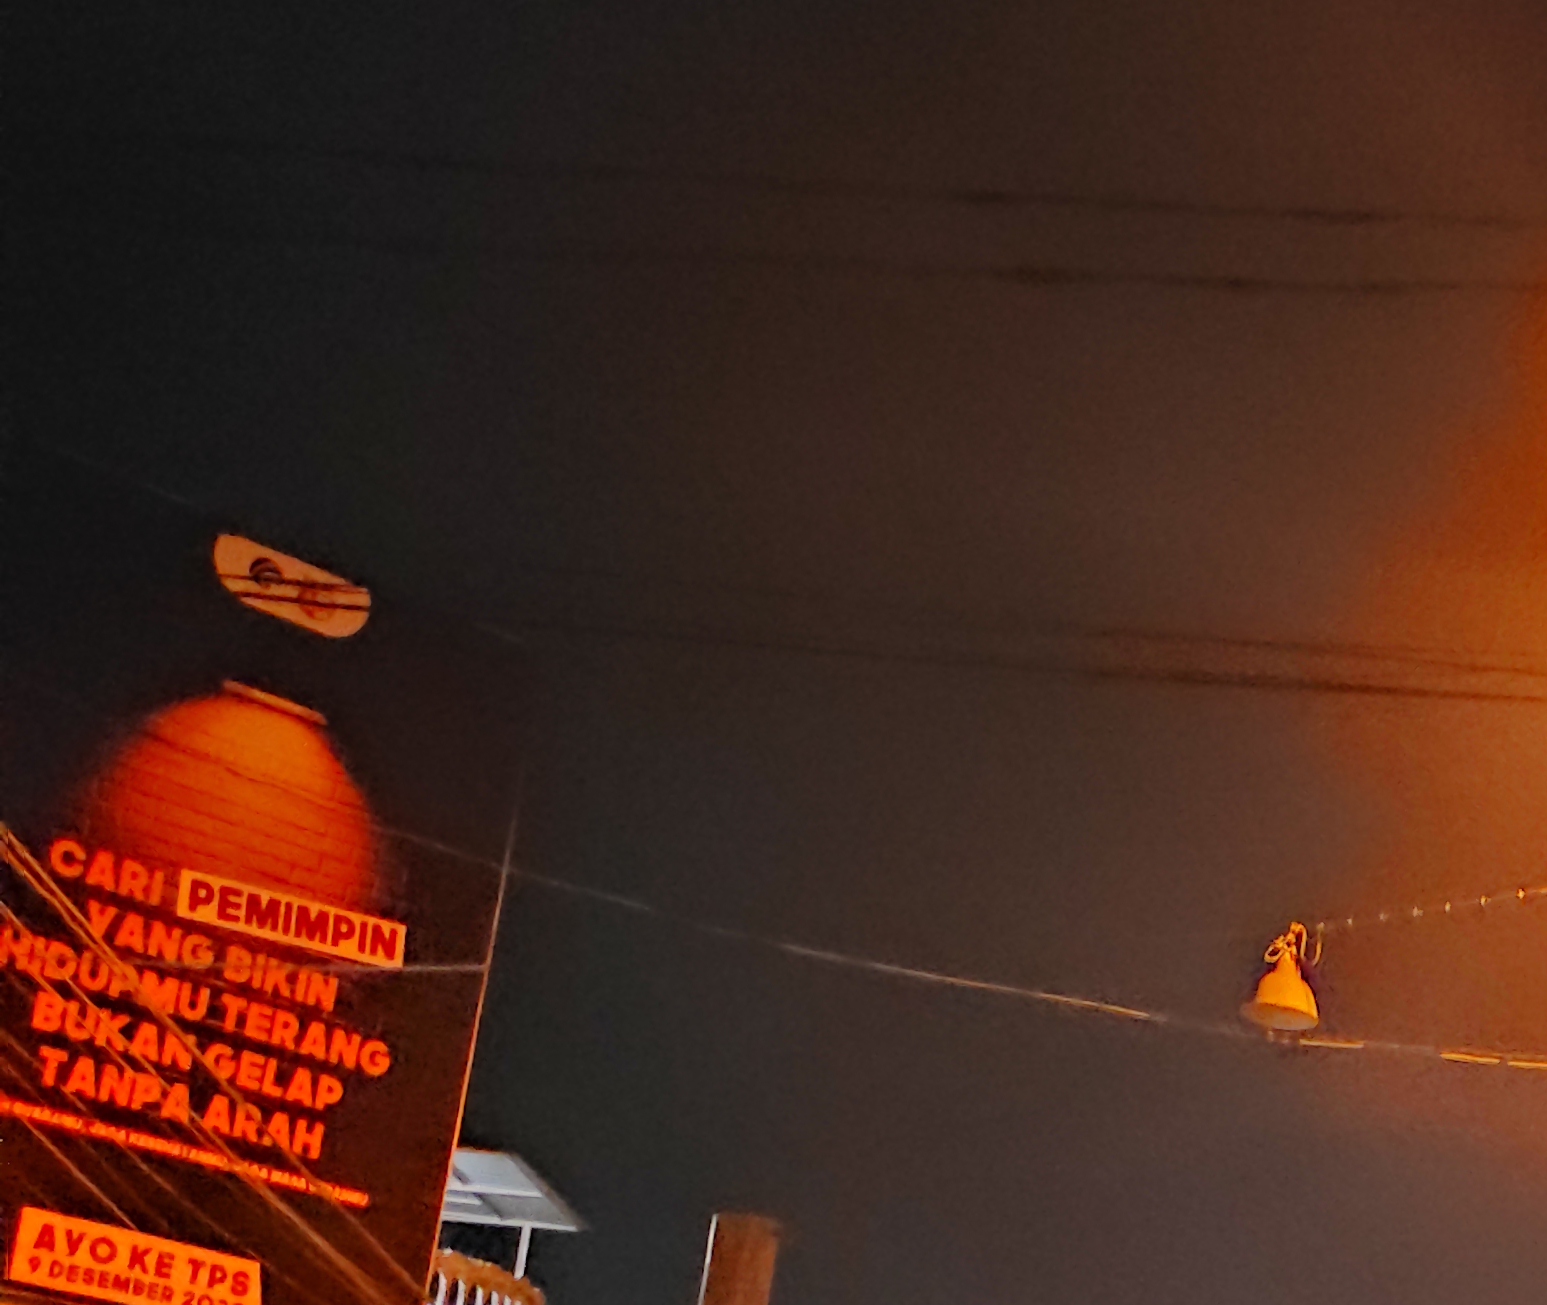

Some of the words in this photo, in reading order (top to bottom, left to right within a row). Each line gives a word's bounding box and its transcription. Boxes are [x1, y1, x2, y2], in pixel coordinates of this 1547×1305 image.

[49, 839, 164, 906] CARI
[187, 878, 399, 961] PEMIMPIN
[88, 900, 214, 968] YANG
[223, 944, 339, 1013] BIKIN
[31, 991, 197, 1071] BUKAN
[201, 1043, 344, 1111] GELAP
[220, 993, 391, 1077] TERANG
[38, 1046, 191, 1124] TANPA
[202, 1094, 326, 1160] ARAH
[27, 1255, 42, 1275] 9
[48, 1261, 174, 1304] DESEMBER
[33, 1222, 118, 1265] AYO
[128, 1243, 175, 1281] KE
[187, 1258, 251, 1298] TPS
